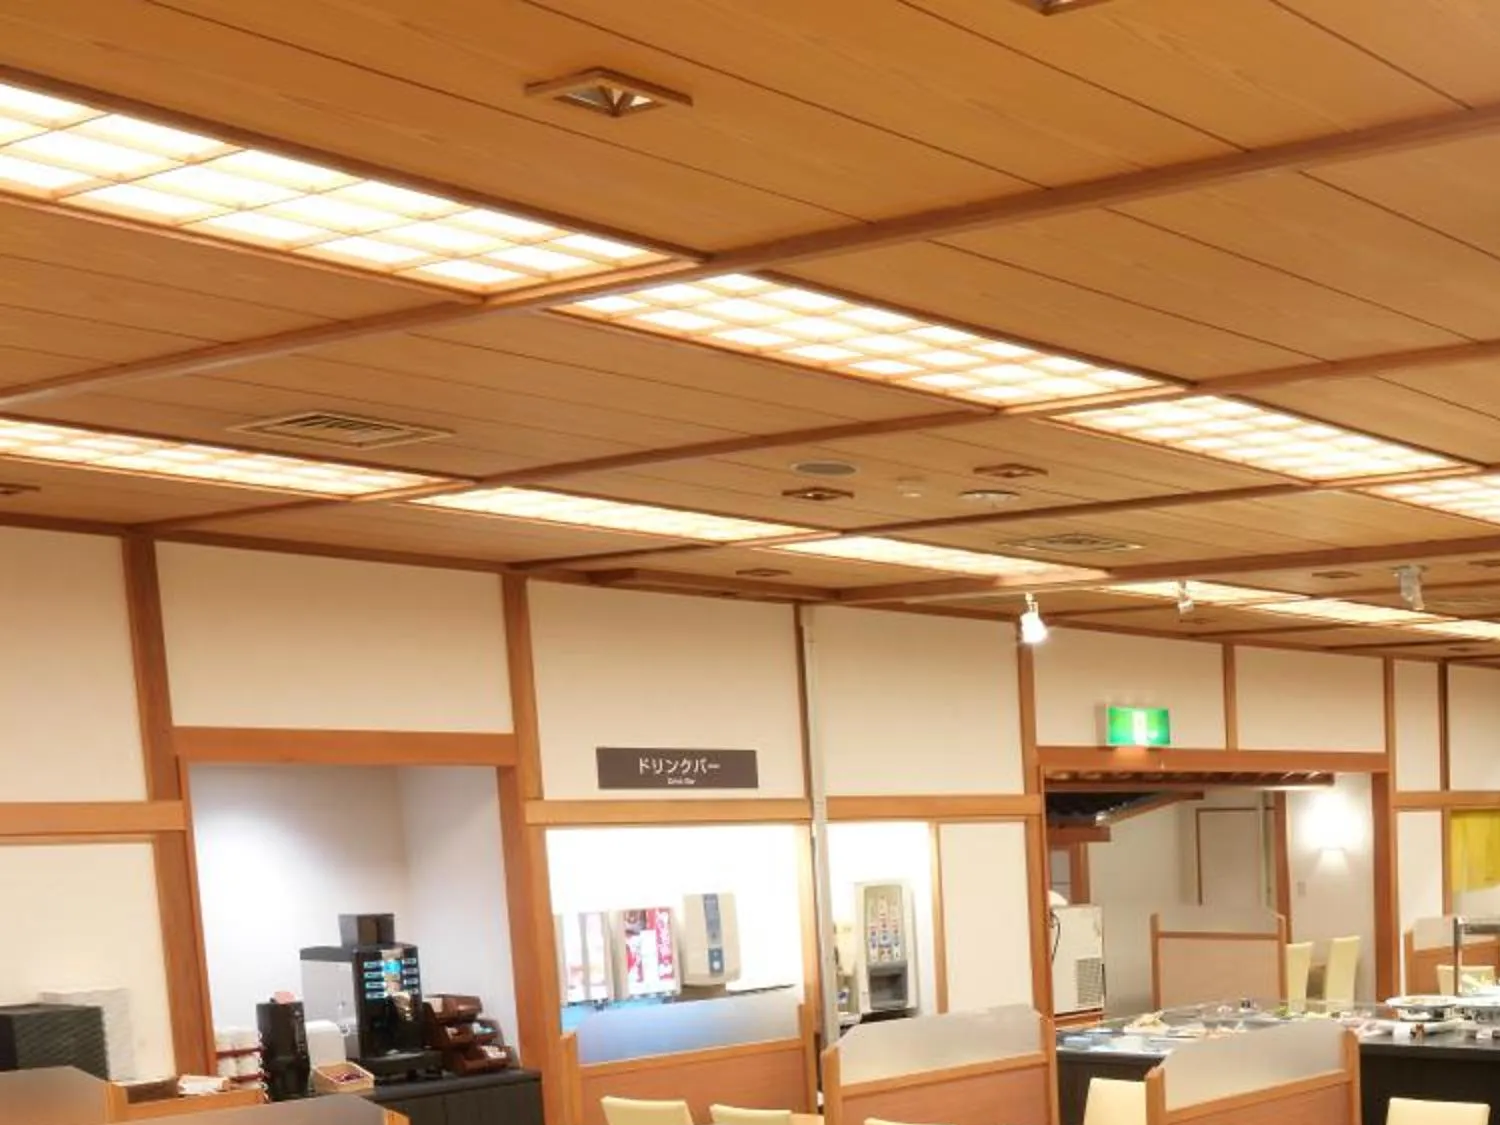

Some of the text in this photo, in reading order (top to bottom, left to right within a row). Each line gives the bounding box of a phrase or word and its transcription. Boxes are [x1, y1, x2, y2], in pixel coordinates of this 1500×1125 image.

[639, 757, 720, 775] ドリンクバー
